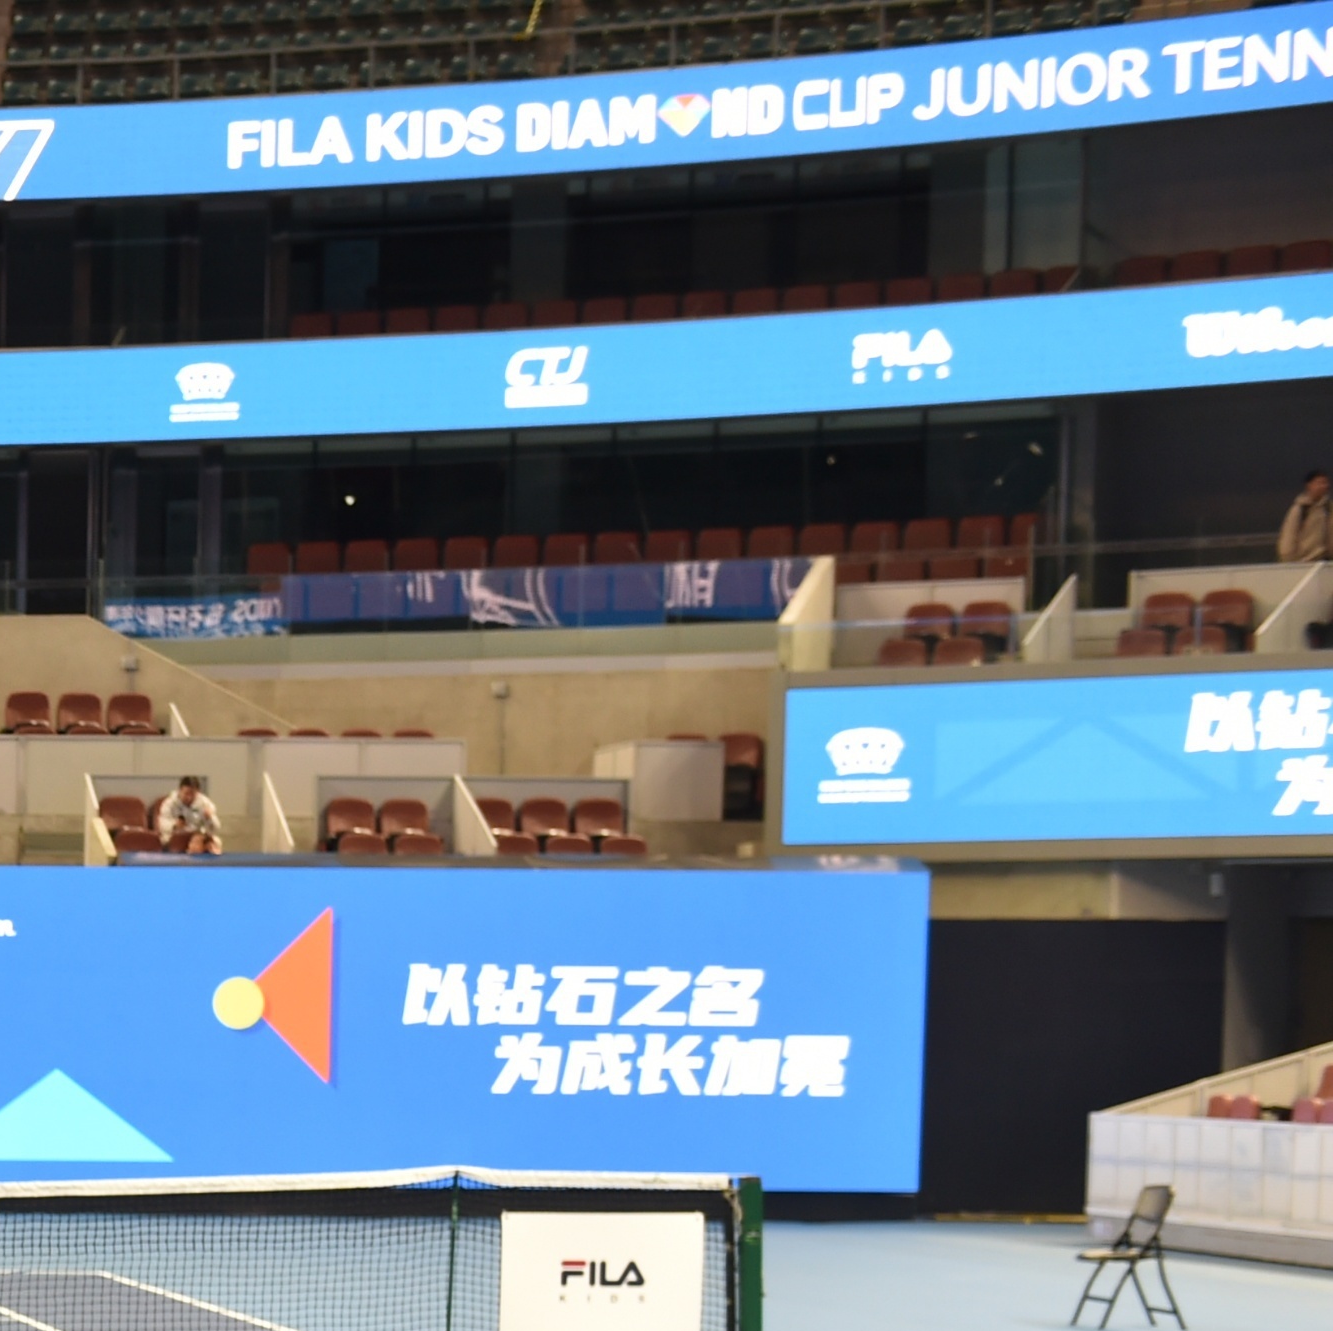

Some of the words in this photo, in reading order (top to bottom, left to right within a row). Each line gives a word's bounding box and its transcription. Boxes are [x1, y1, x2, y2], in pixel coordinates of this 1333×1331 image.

[227, 116, 354, 169] FILA
[366, 105, 505, 162] KIDS
[516, 84, 785, 152] DIAMND
[793, 72, 905, 131] CUP
[912, 48, 1151, 120] JUNIOR
[505, 346, 589, 386] CTJ
[852, 329, 953, 368] FILA
[403, 964, 764, 1026] 以钻石之名
[491, 1033, 850, 1097] 为成长加冕
[561, 1260, 645, 1286] FILA
[559, 1294, 645, 1303] KIDS
